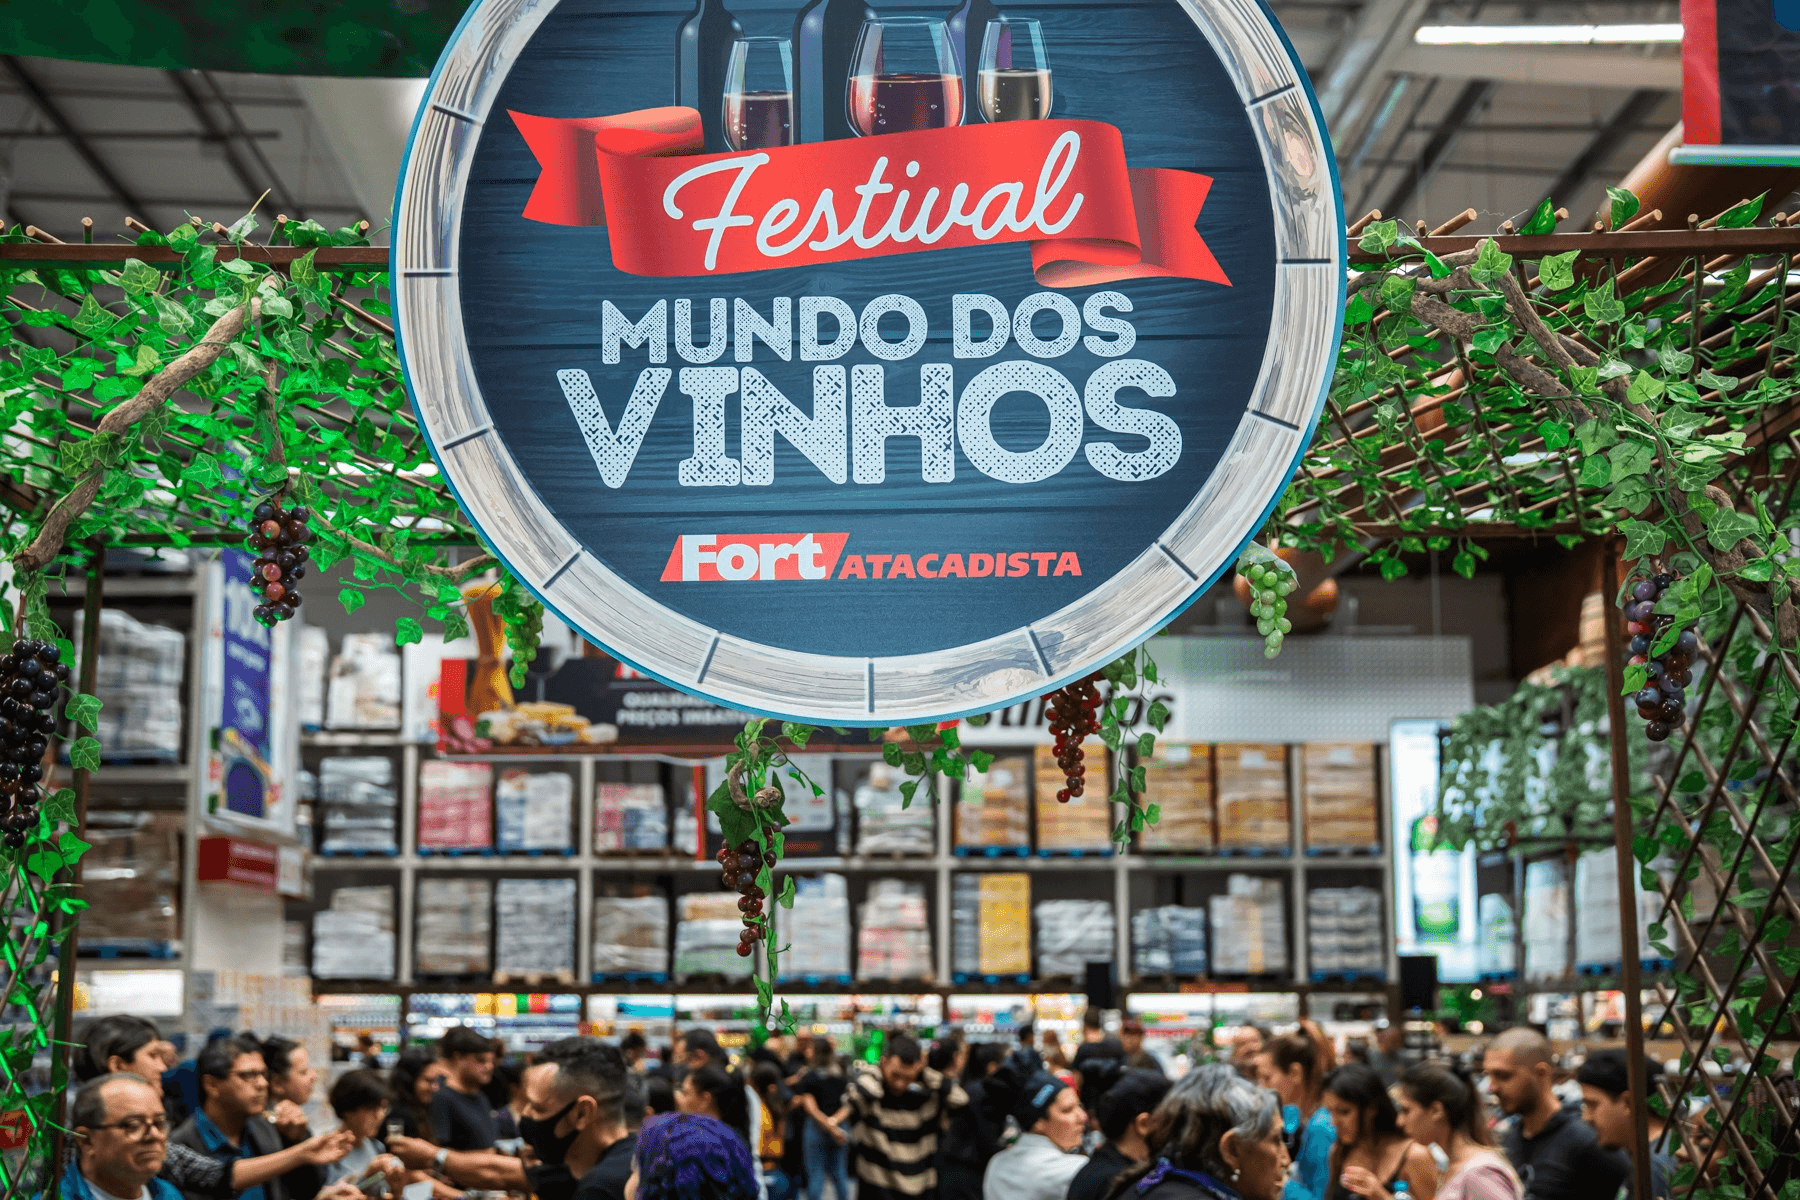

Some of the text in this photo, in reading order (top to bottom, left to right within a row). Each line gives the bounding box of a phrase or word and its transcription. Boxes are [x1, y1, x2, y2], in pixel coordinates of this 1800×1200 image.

[663, 130, 1085, 271] Festival
[602, 290, 1137, 365] MUNDO DOS
[556, 358, 1183, 489] VINHOS
[681, 532, 1083, 582] Fort ATACADISTA
